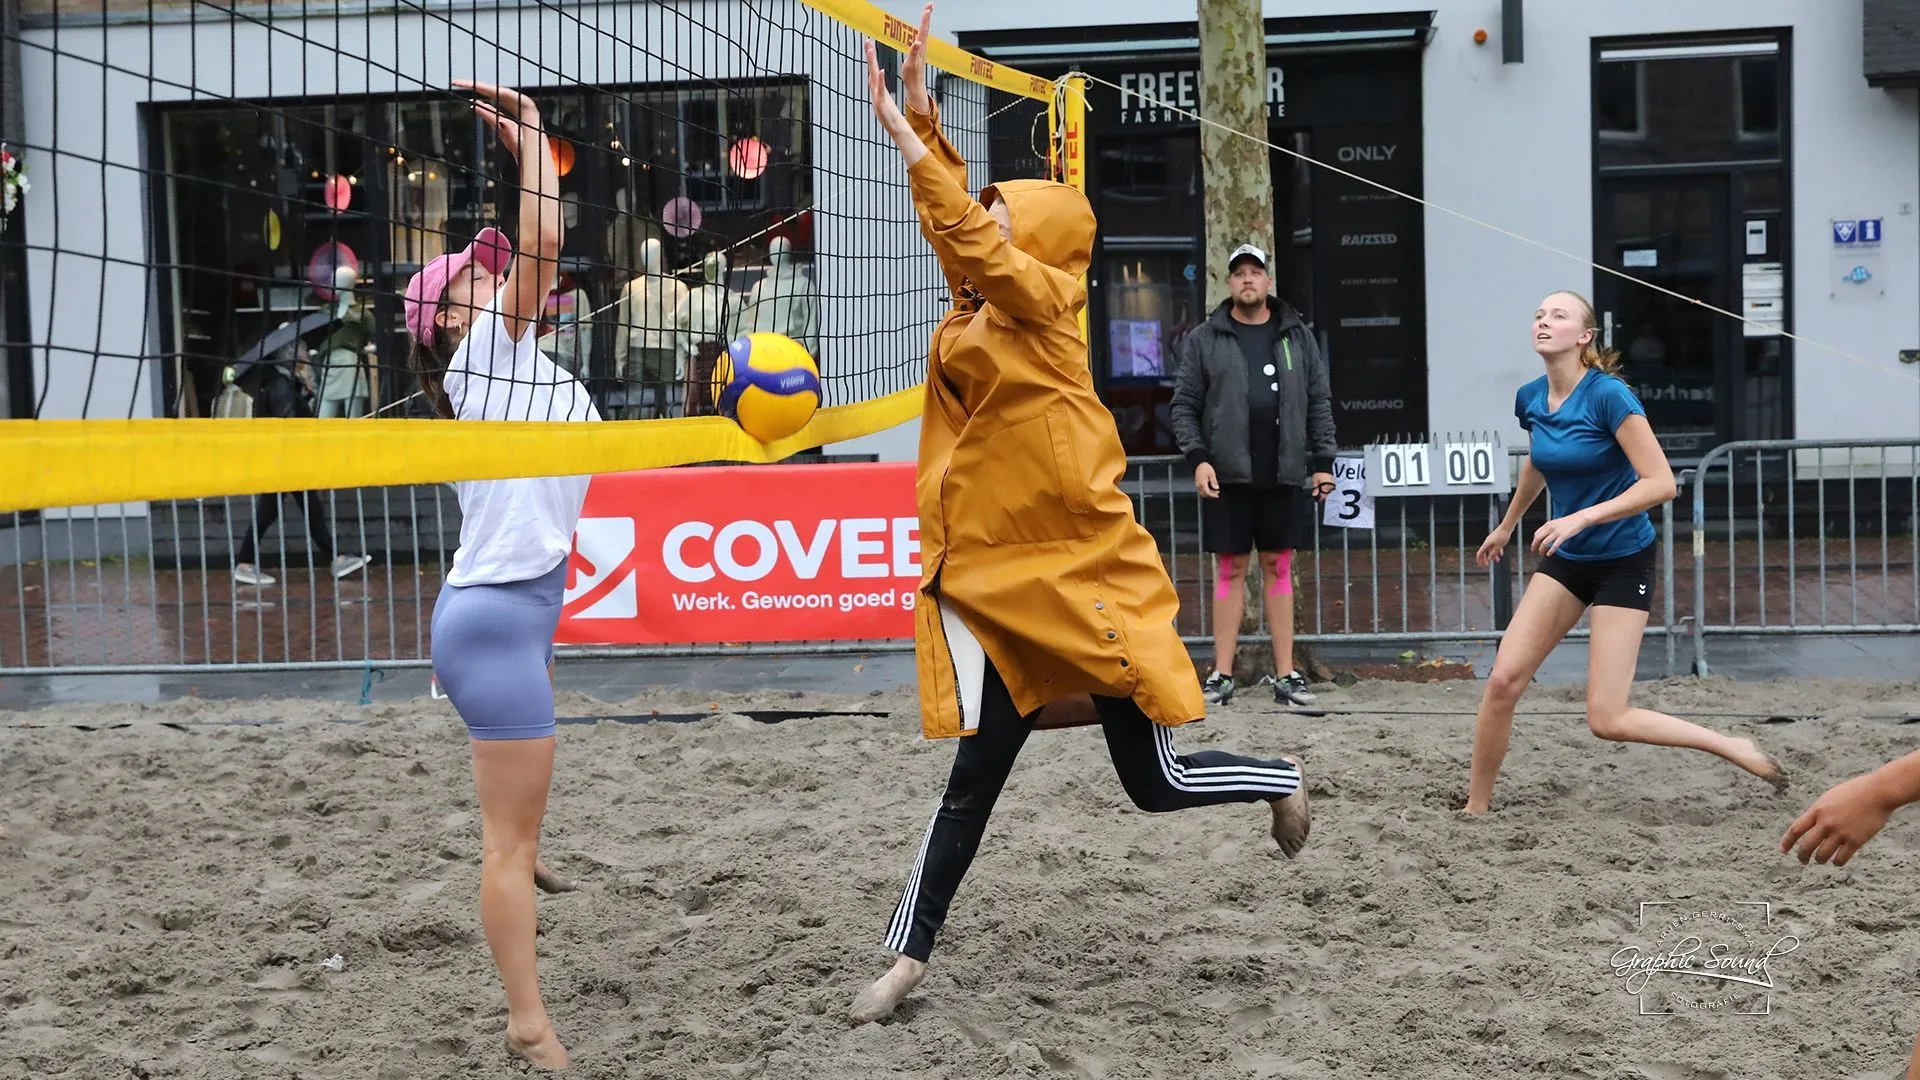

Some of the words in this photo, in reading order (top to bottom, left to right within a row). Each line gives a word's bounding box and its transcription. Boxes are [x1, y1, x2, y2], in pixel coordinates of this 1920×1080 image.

[1338, 145, 1397, 161] ONLY
[1340, 399, 1404, 411] VINGINO
[1384, 451, 1424, 483] 01
[1449, 449, 1490, 482] 00
[1338, 489, 1361, 520] 3
[671, 592, 736, 611] Werk.
[741, 590, 833, 610] Gewoon
[838, 588, 895, 612] goed
